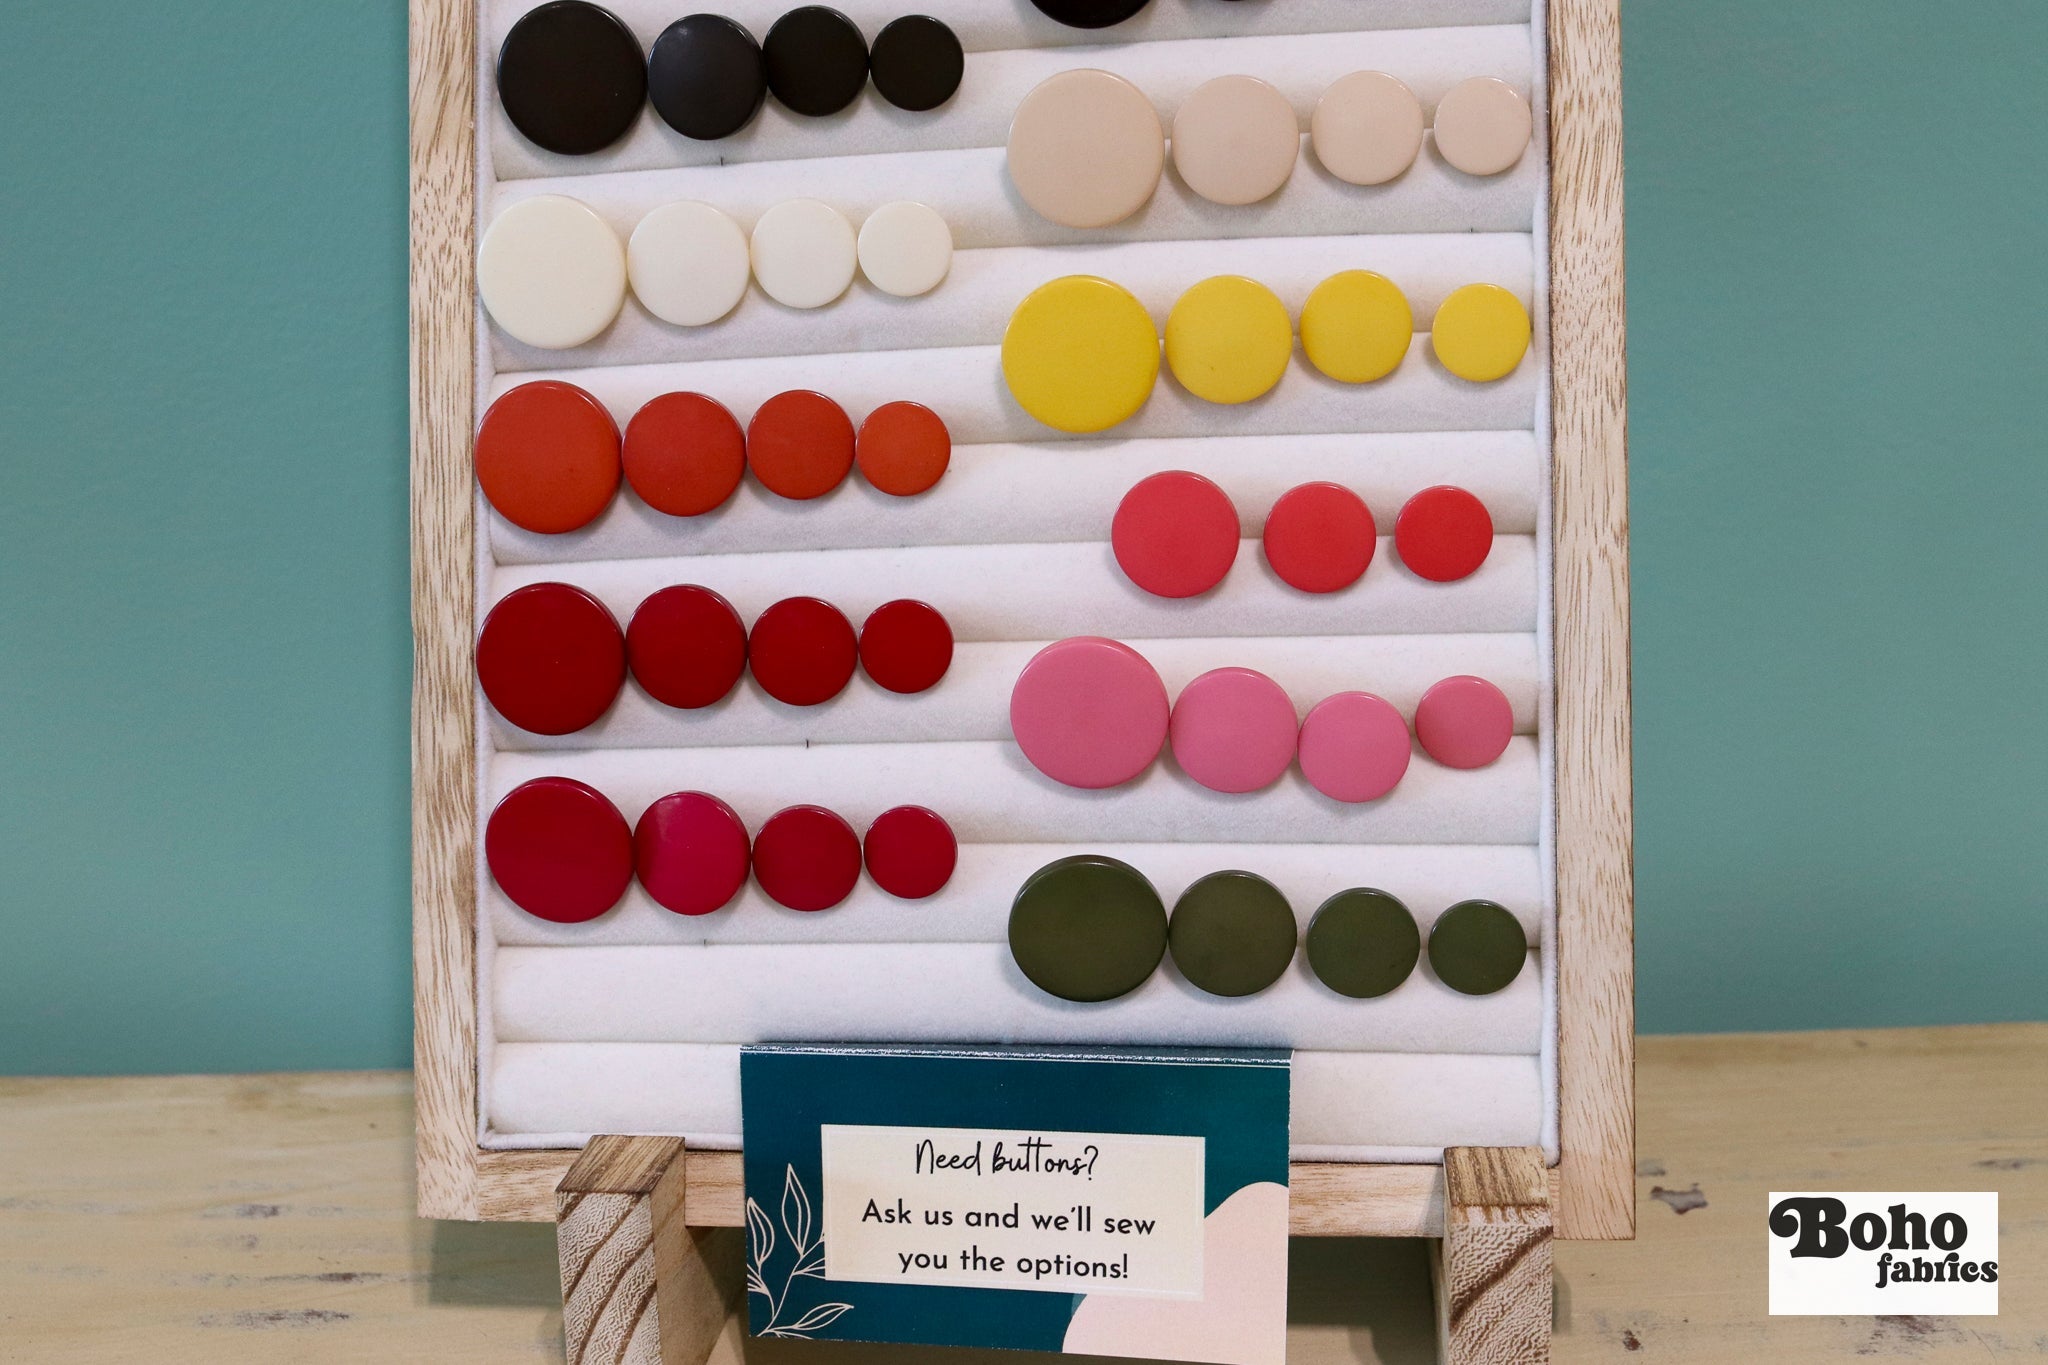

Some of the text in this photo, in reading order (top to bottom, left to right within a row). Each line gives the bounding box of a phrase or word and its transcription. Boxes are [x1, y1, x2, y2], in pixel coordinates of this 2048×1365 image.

[916, 1136, 1099, 1181] Need buttons?
[861, 1199, 912, 1225] Ask
[924, 1210, 953, 1226] us
[965, 1202, 1019, 1230] and
[1104, 1217, 1156, 1236] sew
[898, 1245, 1129, 1281] you the options!
